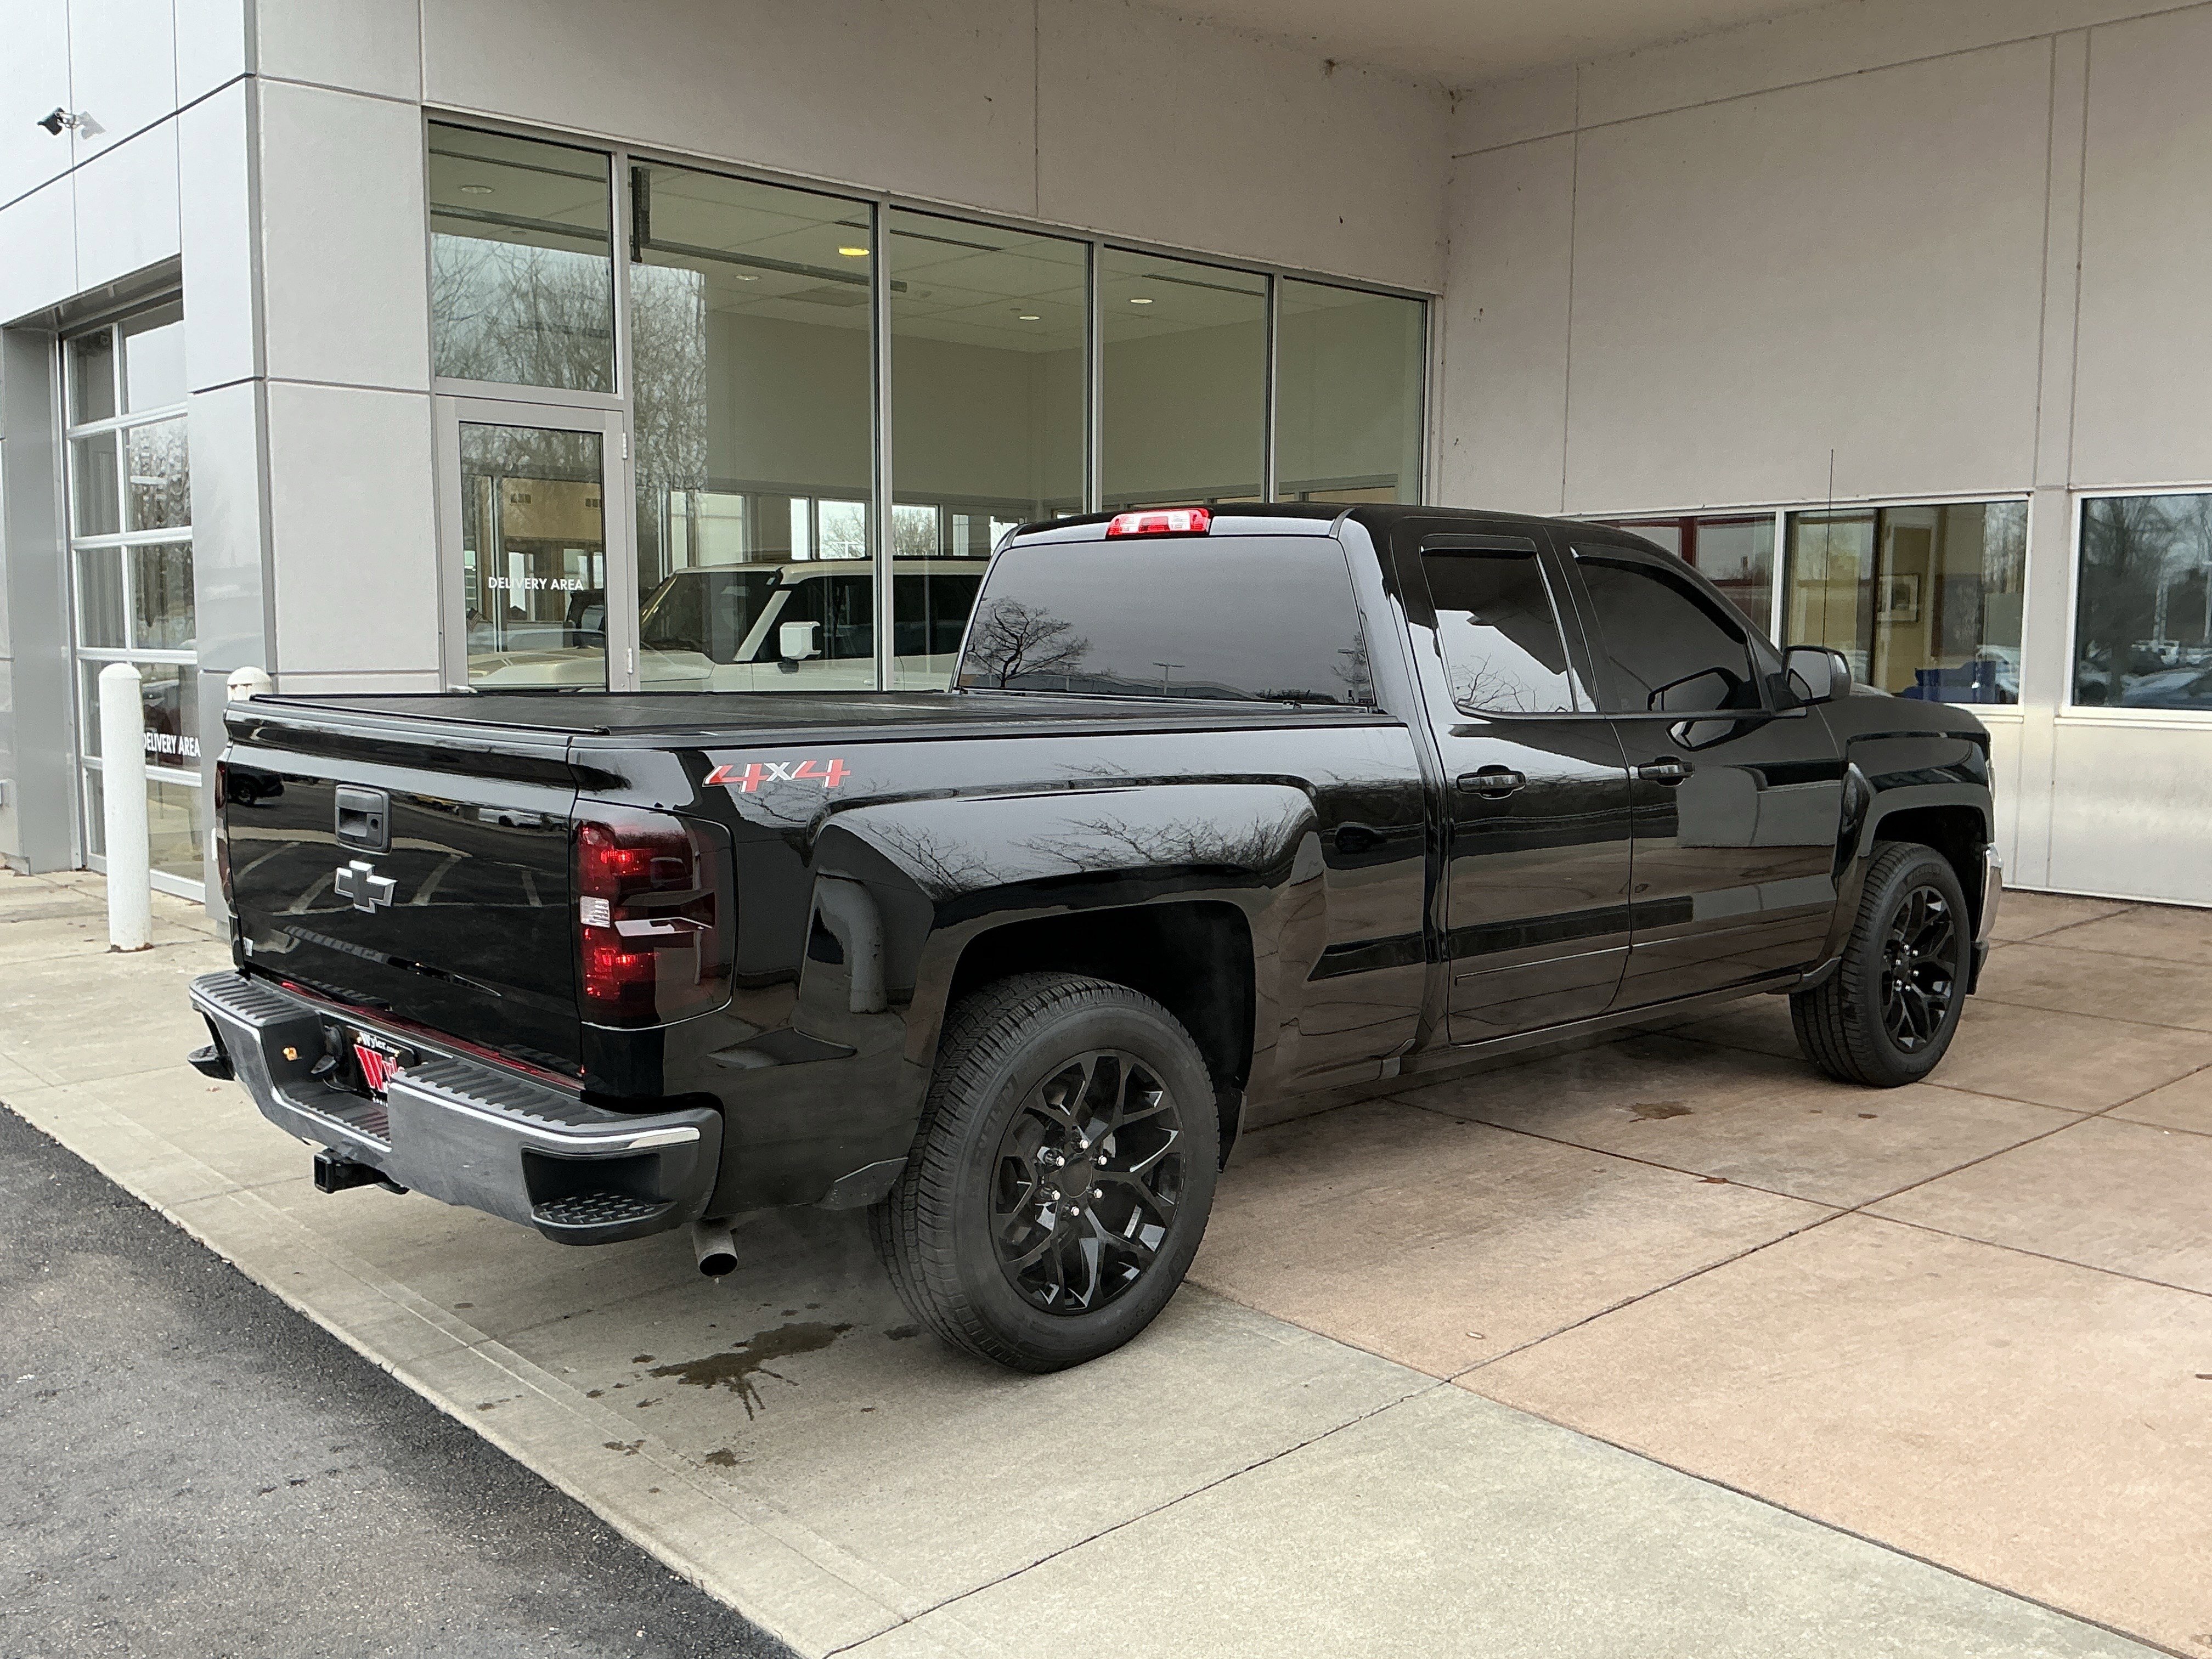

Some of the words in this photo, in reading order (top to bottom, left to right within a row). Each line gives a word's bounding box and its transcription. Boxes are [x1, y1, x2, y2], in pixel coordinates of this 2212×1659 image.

[488, 577, 548, 590] DELIVERY
[550, 578, 584, 591] AREA
[178, 736, 201, 758] AREA
